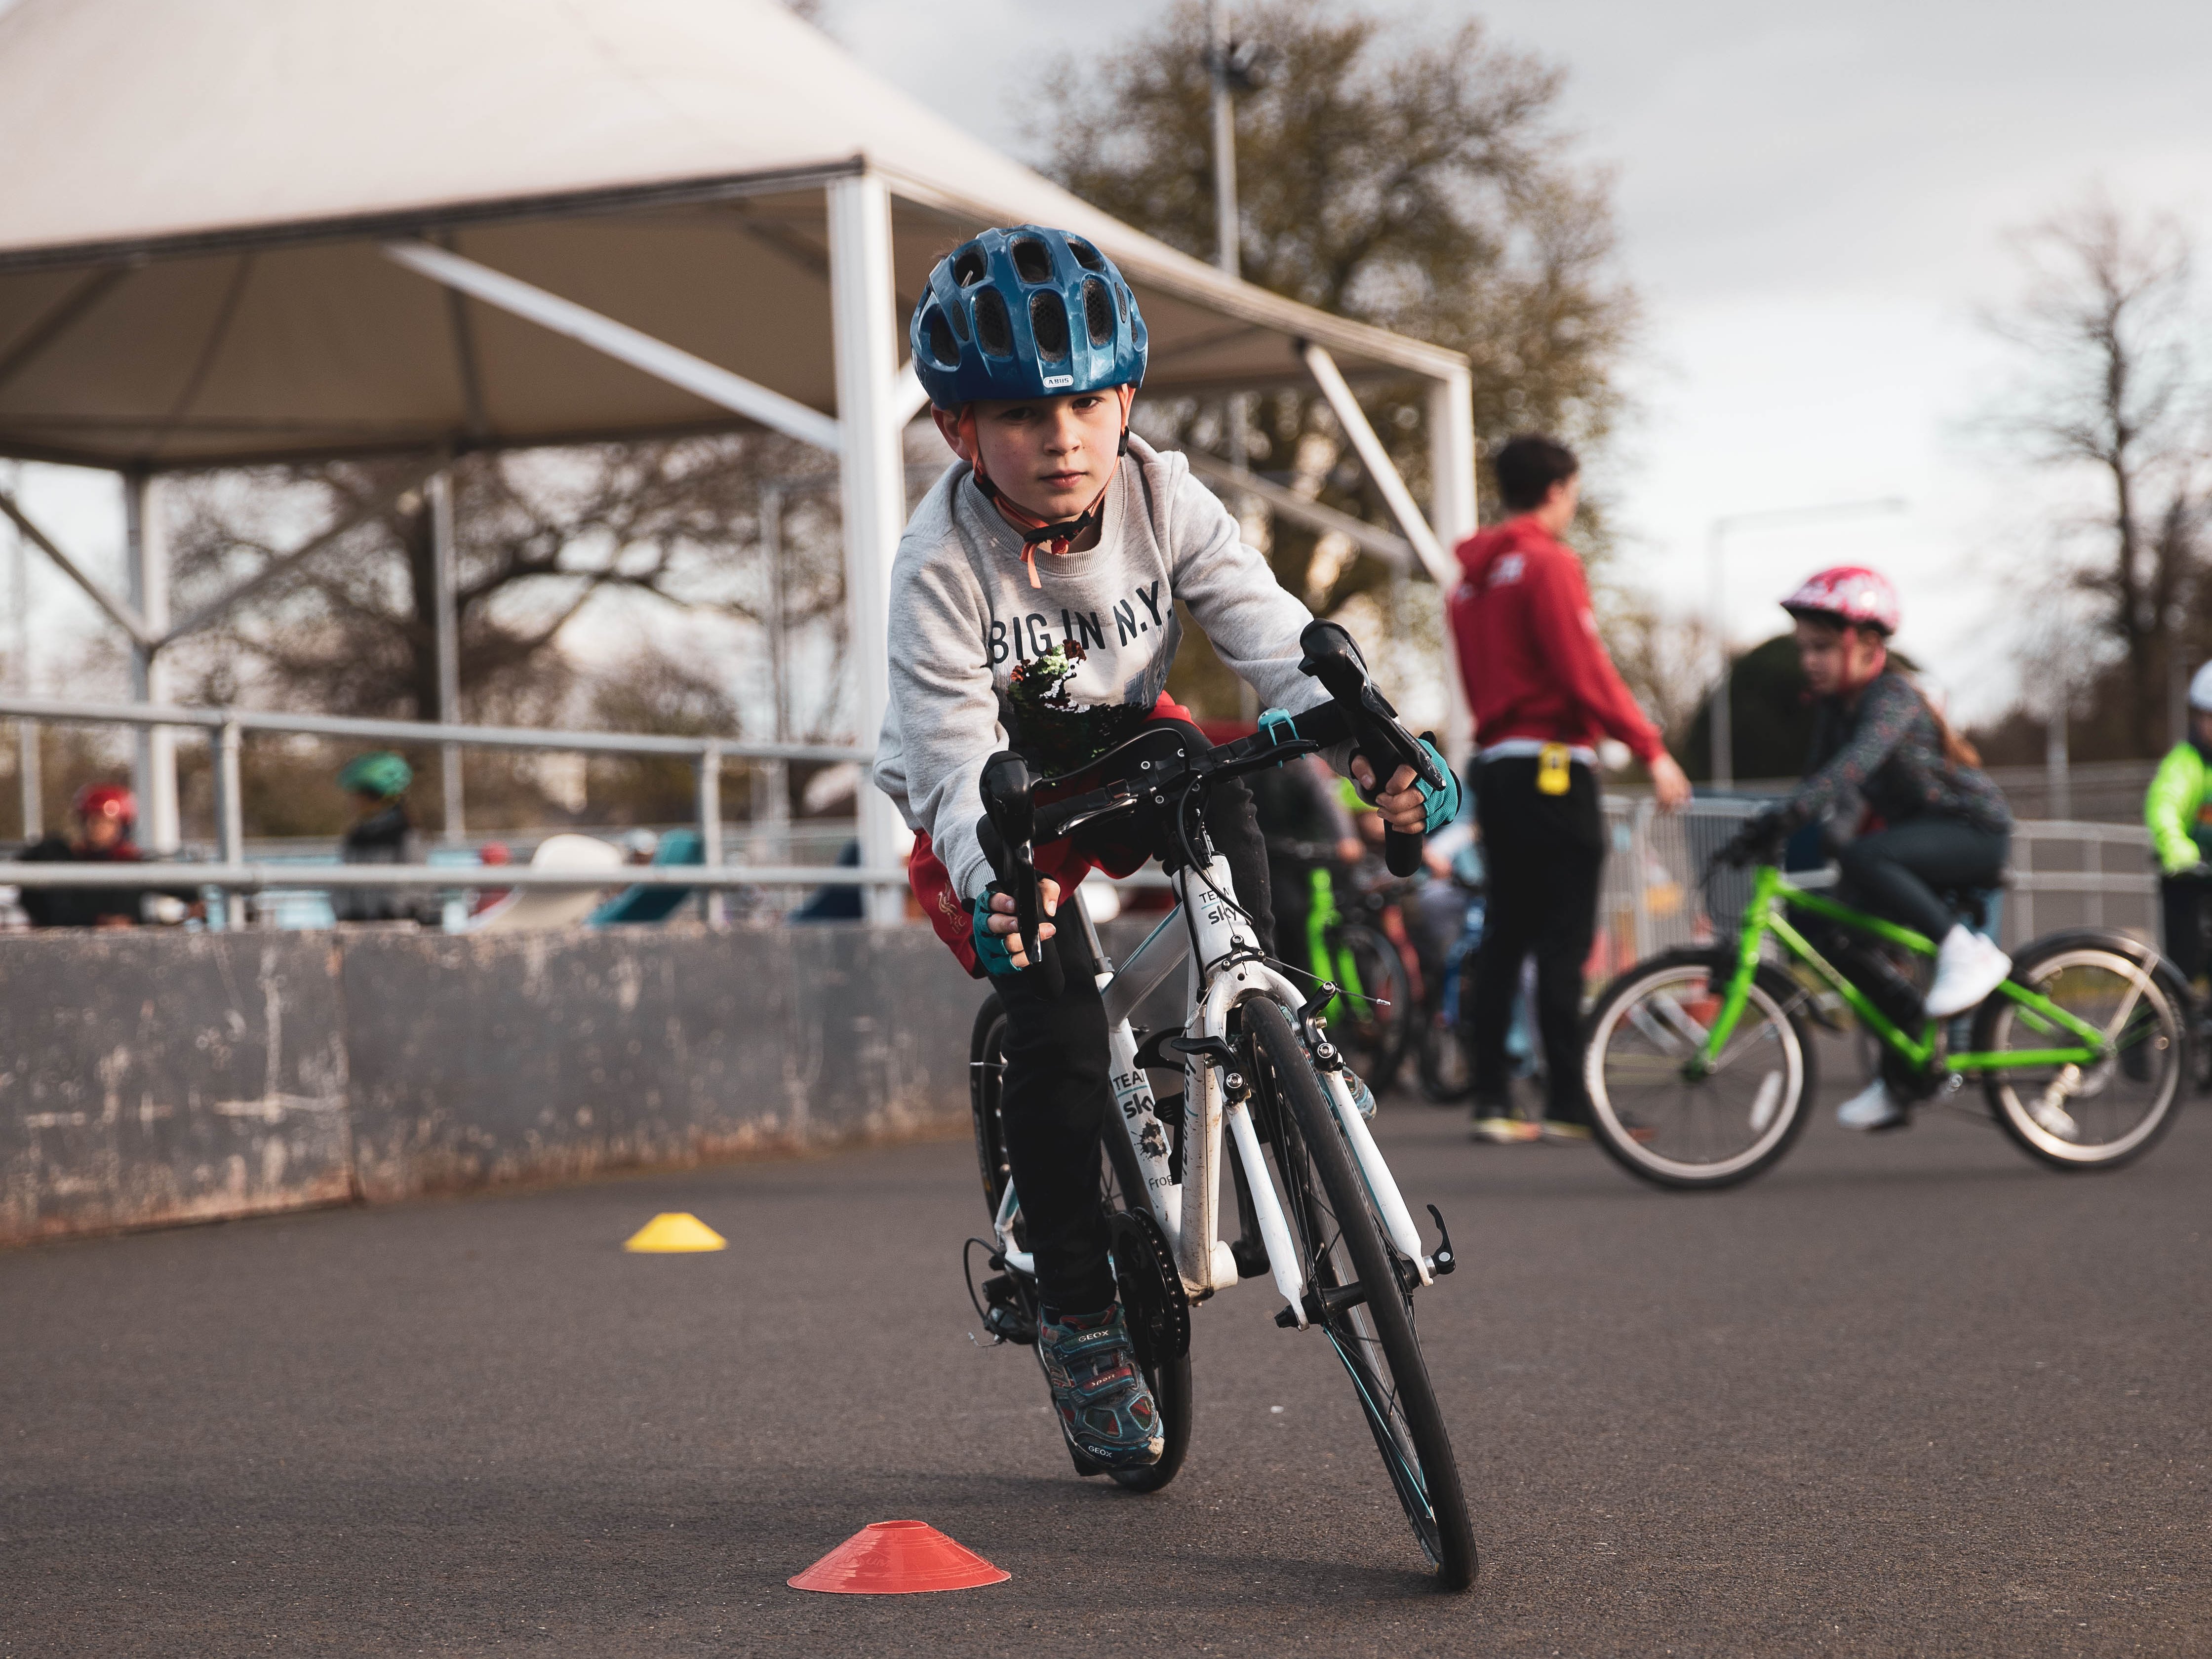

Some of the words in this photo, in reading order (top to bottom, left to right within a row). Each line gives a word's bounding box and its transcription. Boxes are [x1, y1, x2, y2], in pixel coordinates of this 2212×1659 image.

[988, 613, 1053, 664] BIG
[1061, 609, 1106, 650] IN
[1113, 580, 1173, 647] N.Y.
[1199, 887, 1232, 903] TEM
[1113, 1070, 1146, 1091] TEA
[1078, 1330, 1109, 1342] GEOX
[1088, 1446, 1112, 1458] GEOX
